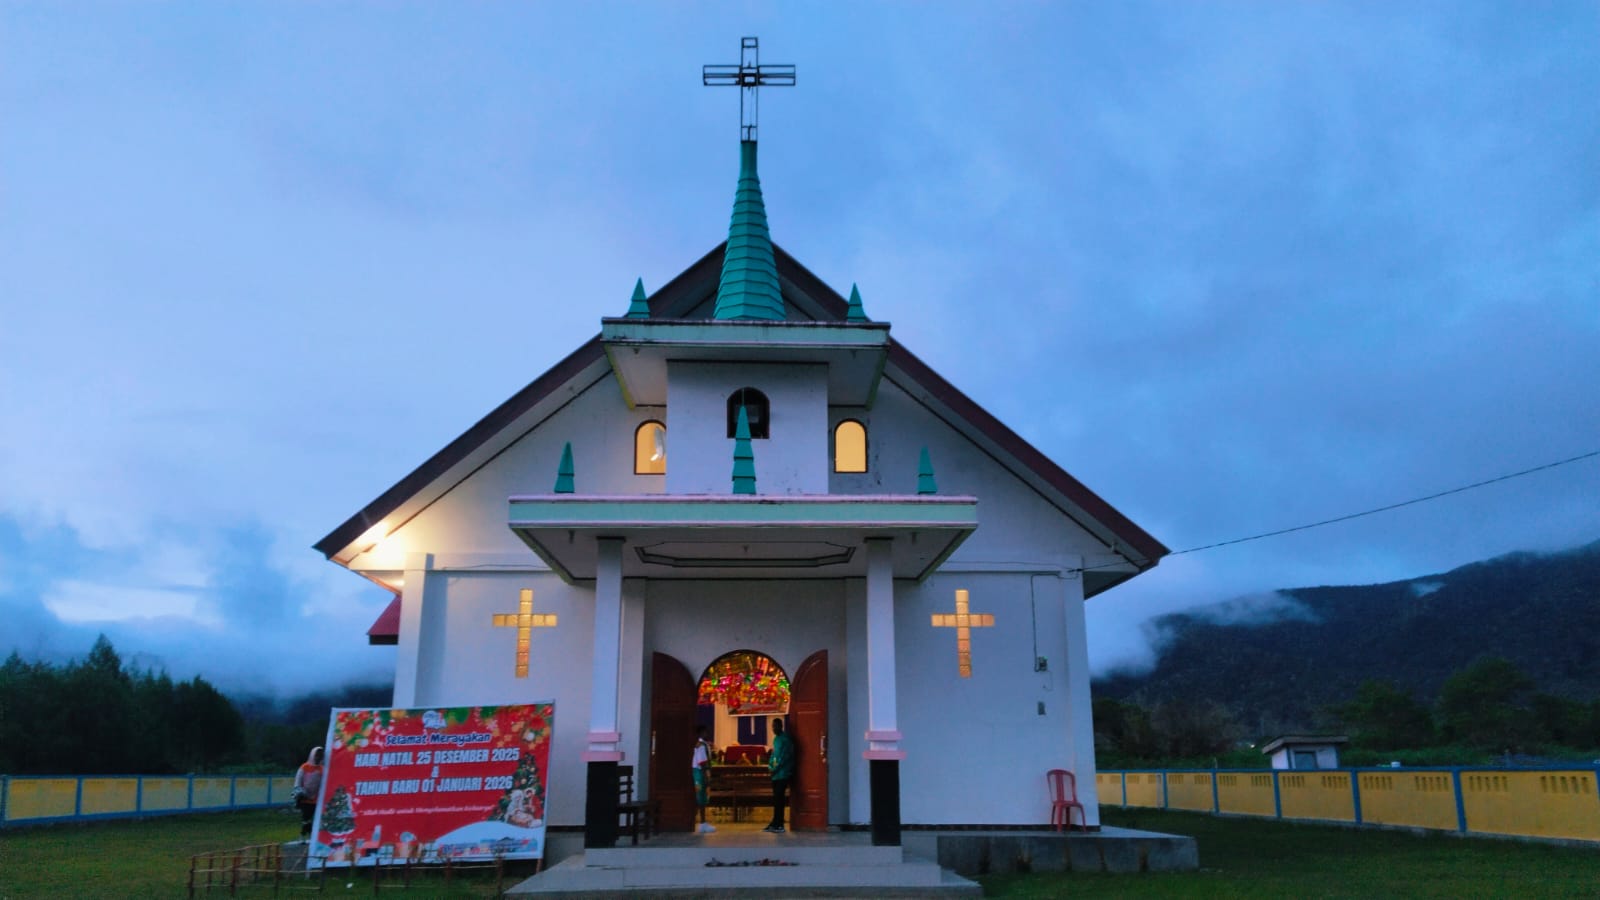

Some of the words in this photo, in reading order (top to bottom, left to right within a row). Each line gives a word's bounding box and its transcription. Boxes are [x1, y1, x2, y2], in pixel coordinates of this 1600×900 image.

[385, 734, 427, 745] Selamat
[430, 733, 491, 746] Merayakan
[354, 753, 380, 767] HARI
[381, 752, 414, 766] NATAL
[416, 751, 432, 764] 25
[433, 749, 489, 764] DESEMBER
[491, 747, 520, 762] 2025
[355, 781, 390, 796] TAHUN
[391, 779, 420, 794] BARU
[421, 778, 435, 792] 01
[436, 777, 483, 792] JANUARI
[484, 776, 514, 790] 2026
